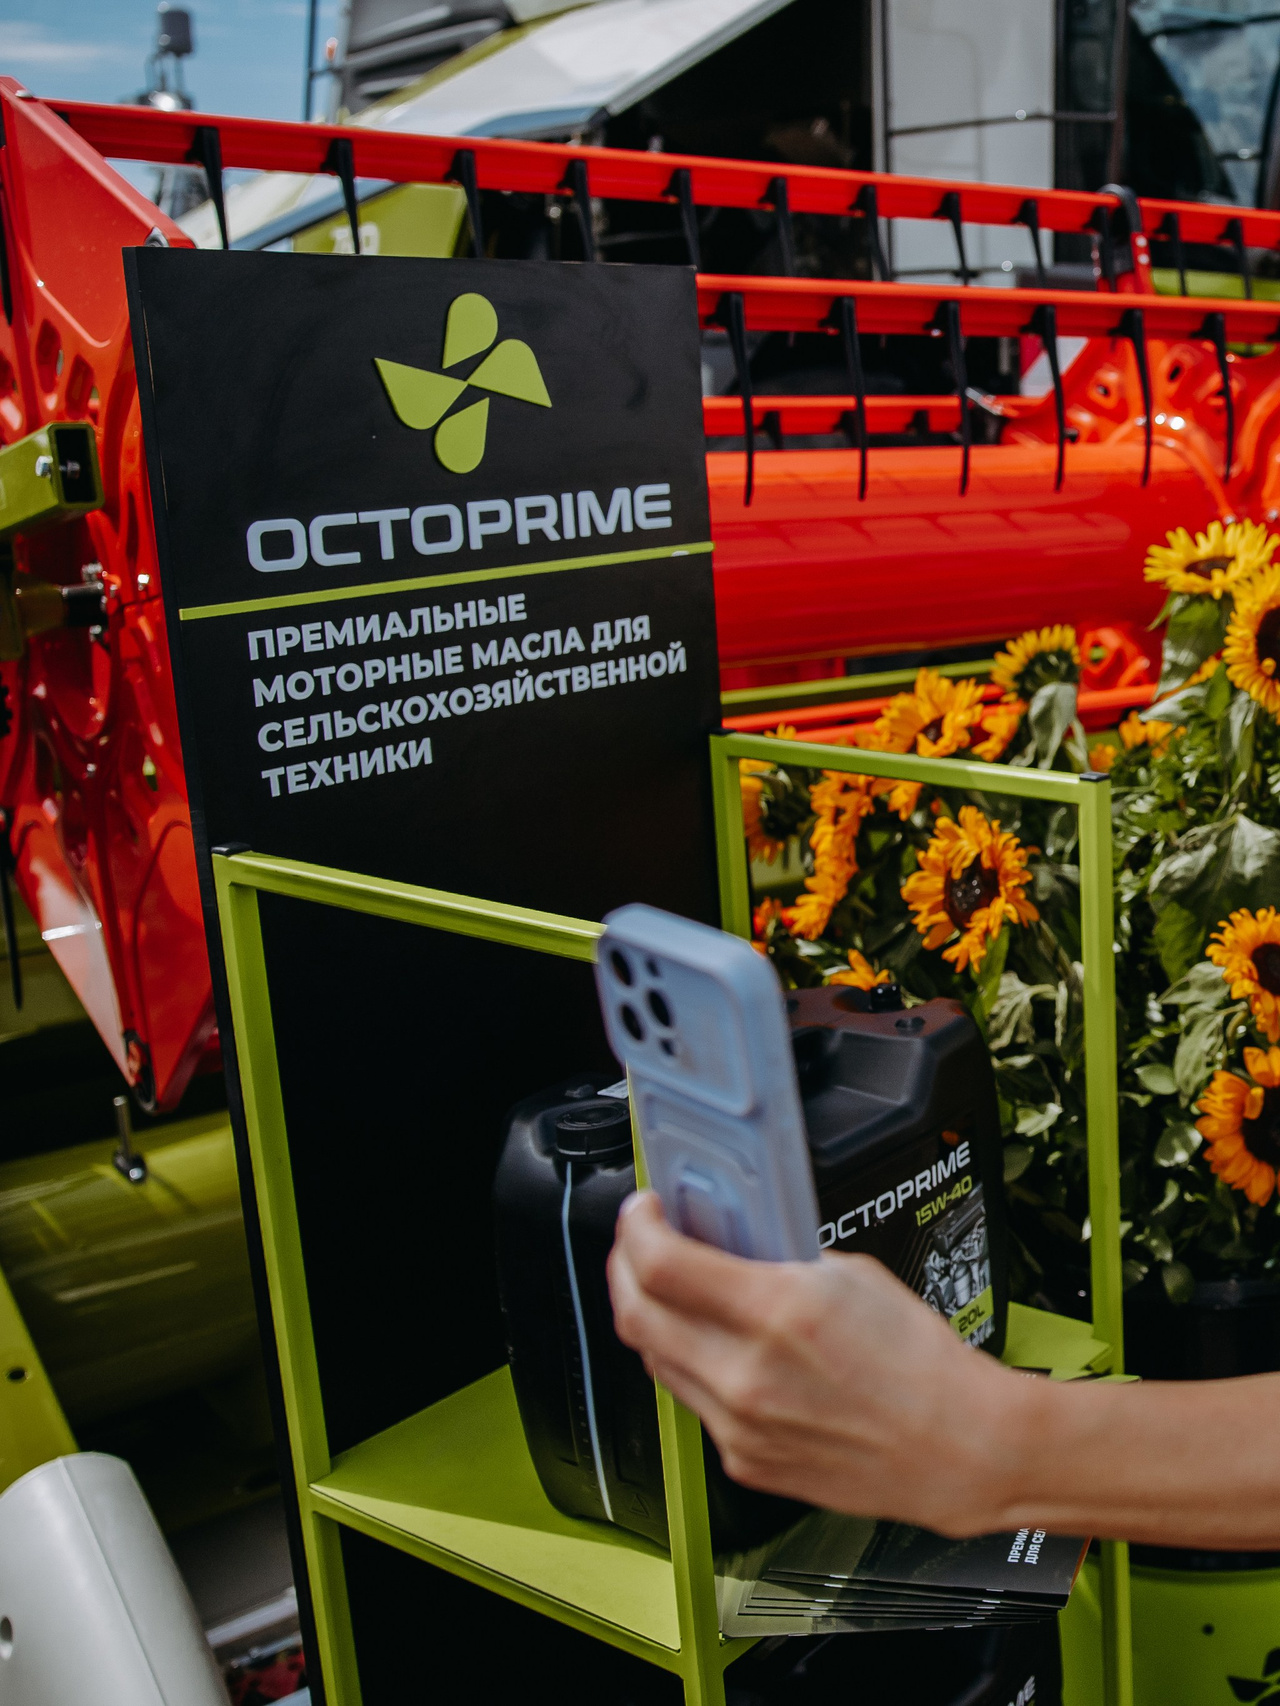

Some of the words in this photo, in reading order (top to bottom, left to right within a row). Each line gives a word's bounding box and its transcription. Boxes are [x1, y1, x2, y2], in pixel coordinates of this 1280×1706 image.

[245, 483, 673, 573] OCTOPRIME
[247, 593, 528, 661] ПРЕМИАЛЬНЫЕ
[252, 646, 463, 708] МОТОРНЫЕ
[471, 626, 586, 671] МАСЛА
[590, 615, 651, 656] ДЛЯ
[257, 641, 688, 753] СЕЛЬСКОХОЗЯЙСТВЕННОЙ
[261, 737, 433, 798] ТЕХНИКИ
[816, 1140, 971, 1250] OCTOPRIME
[915, 1175, 973, 1227] 15W-40
[958, 1304, 986, 1333] 20L
[1024, 1544, 1041, 1565] ДЛЯ
